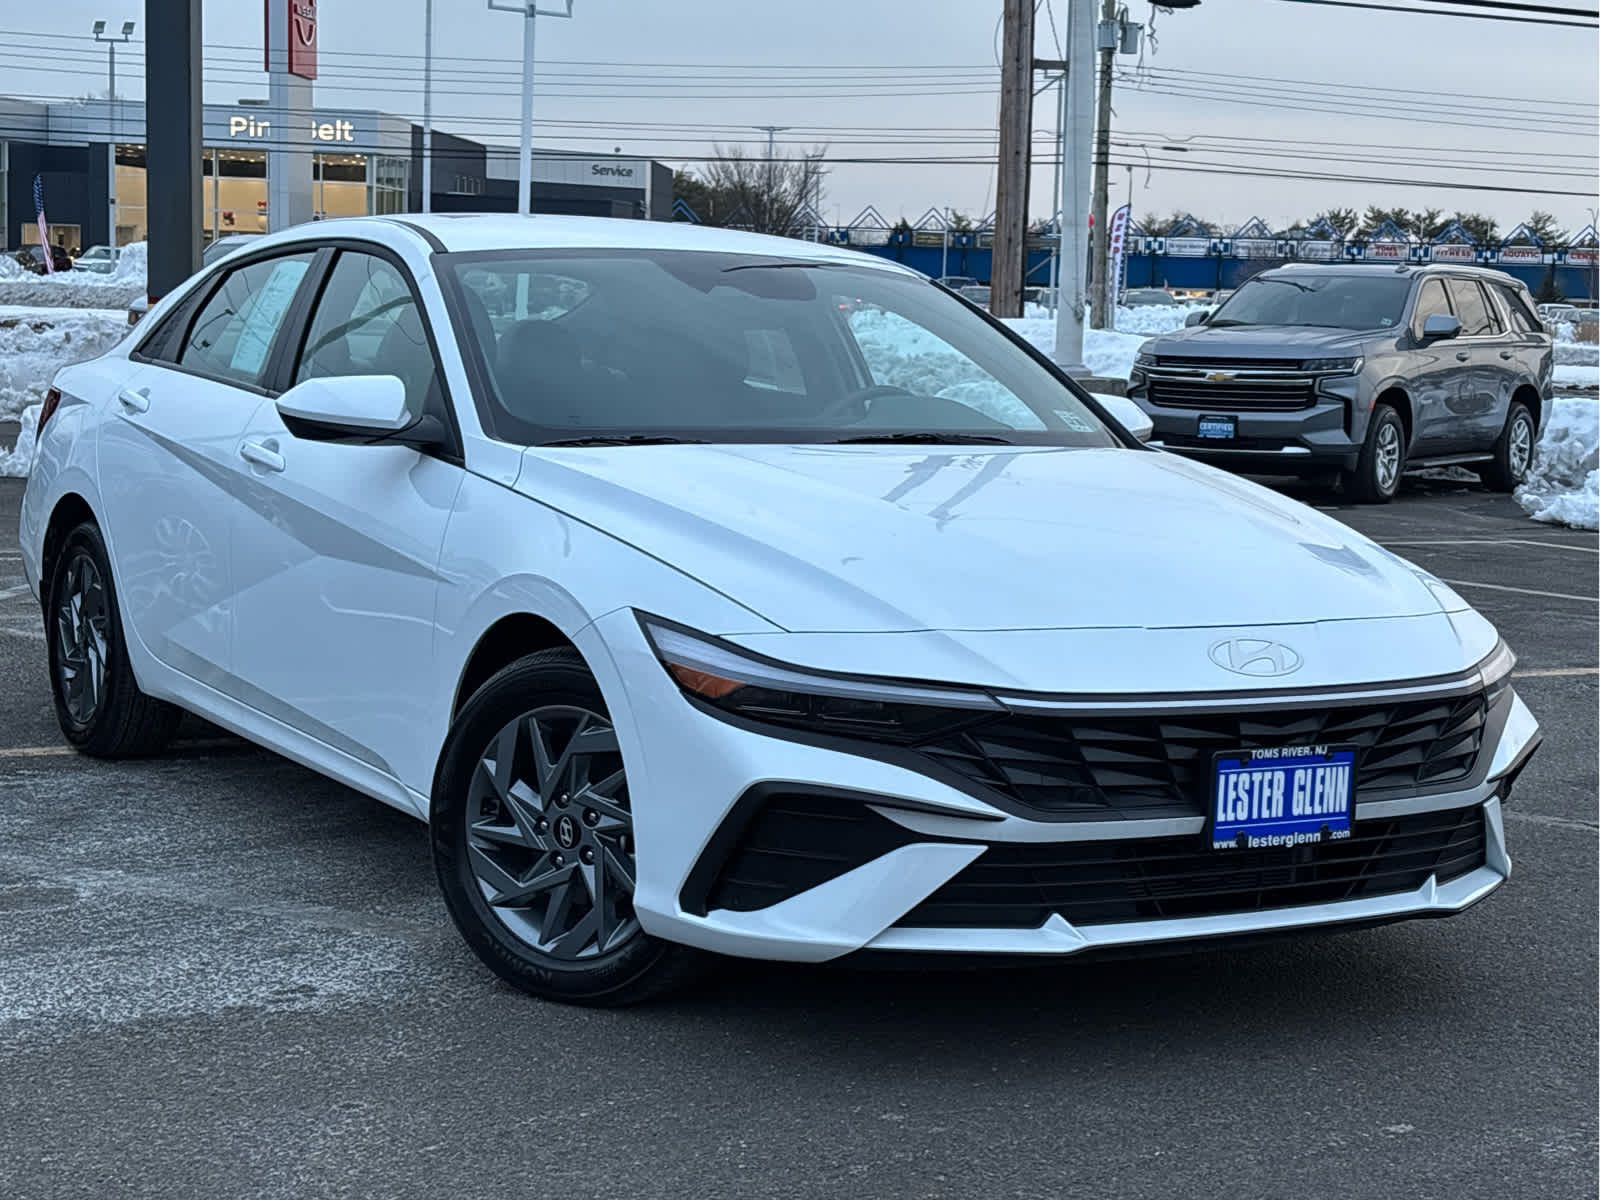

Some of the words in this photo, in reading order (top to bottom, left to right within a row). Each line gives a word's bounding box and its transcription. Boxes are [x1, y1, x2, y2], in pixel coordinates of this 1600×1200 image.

[230, 115, 271, 137] Pin
[592, 164, 633, 177] Service
[1436, 248, 1472, 257] FITNESS
[1503, 249, 1539, 258] AQUATIC
[1251, 748, 1279, 760] TOMS
[1315, 745, 1328, 756] NJ
[1217, 771, 1285, 822] LESTER
[1292, 766, 1350, 816] GLENN
[1213, 839, 1239, 850] www.
[1248, 832, 1321, 848] lesterglenn
[1329, 829, 1351, 840] .com
